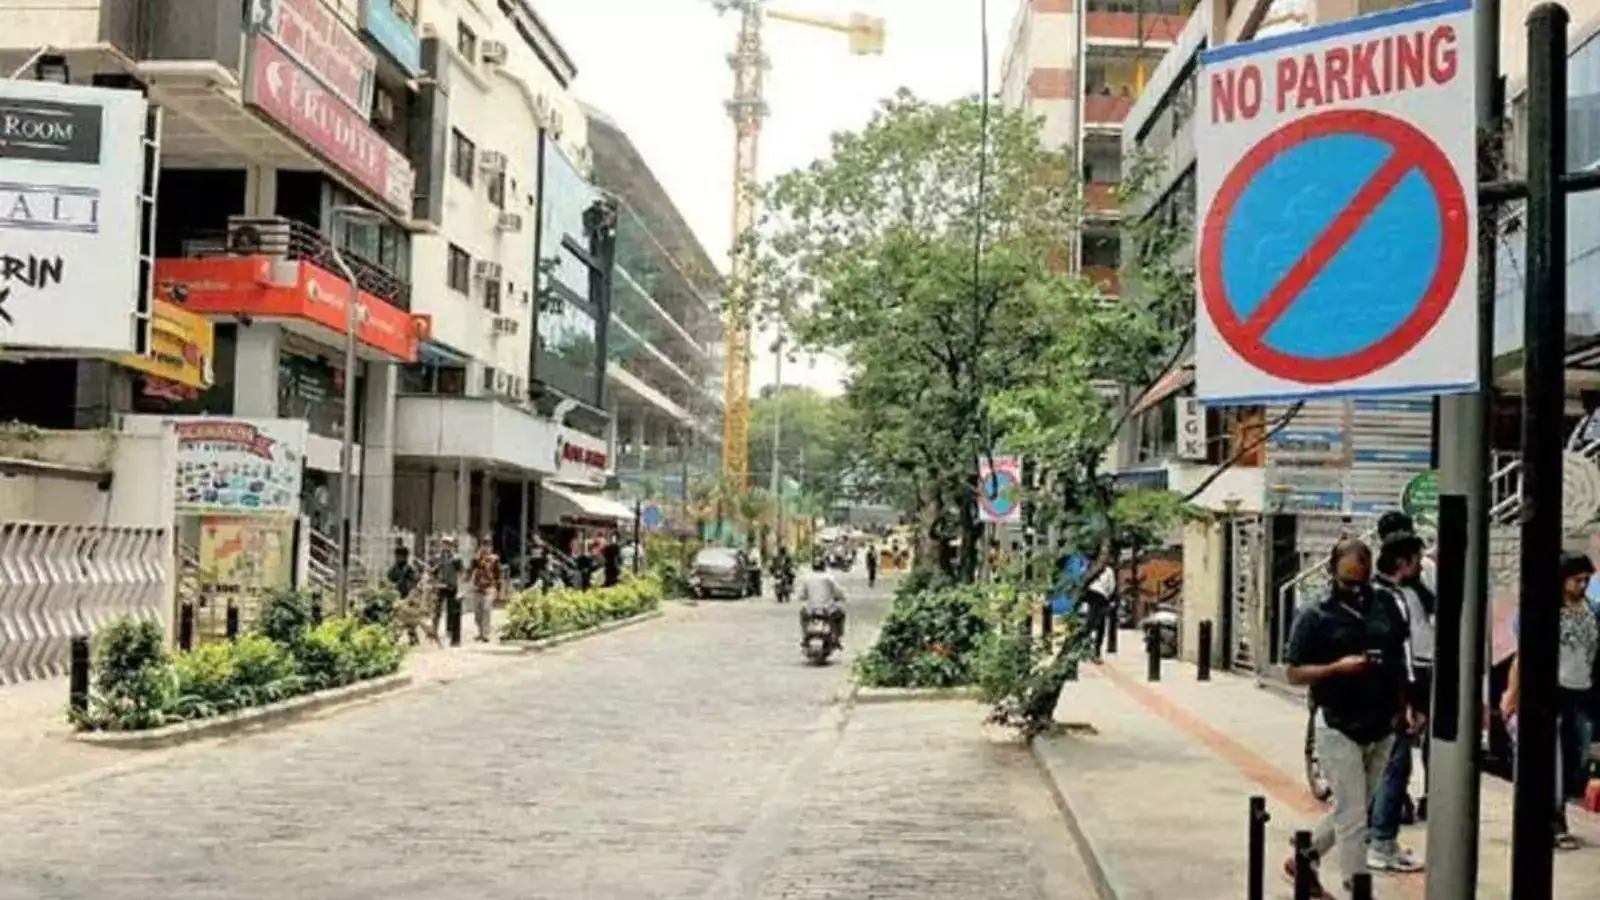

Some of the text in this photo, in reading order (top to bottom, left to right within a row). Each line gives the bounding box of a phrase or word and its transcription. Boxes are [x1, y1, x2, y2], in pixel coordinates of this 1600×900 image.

[1211, 24, 1459, 125] NO PARKING
[4, 115, 75, 141] ROOM
